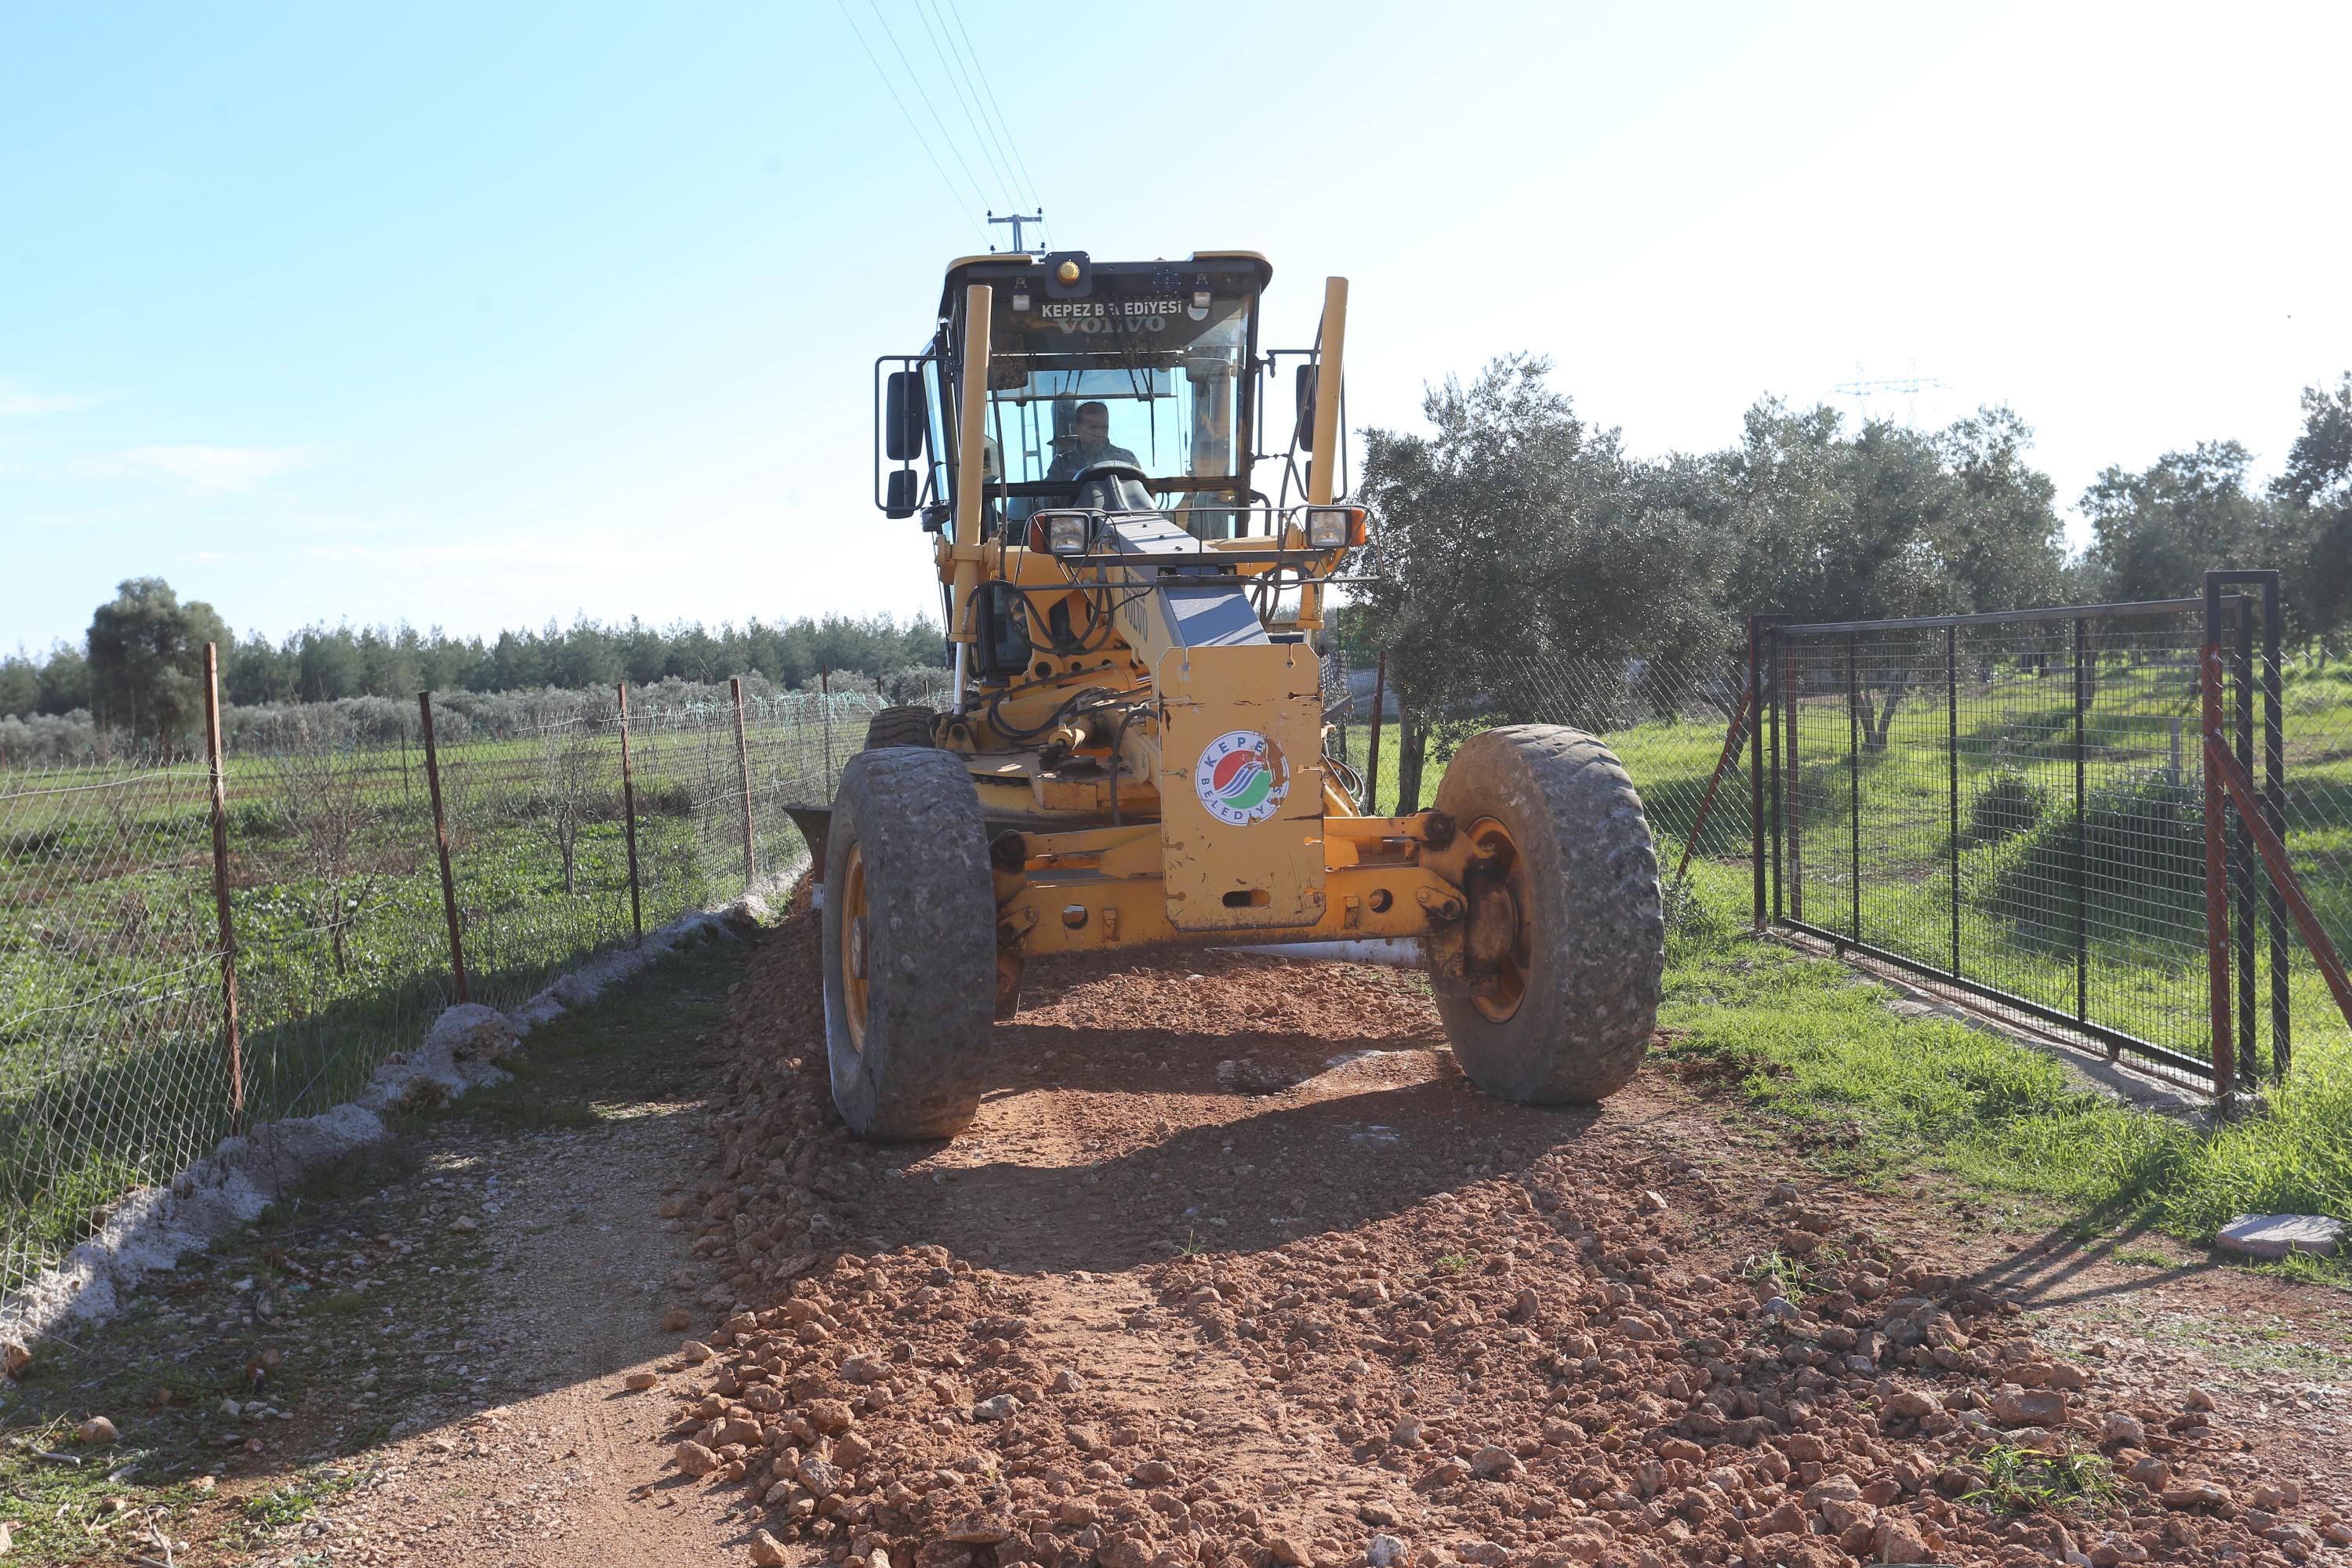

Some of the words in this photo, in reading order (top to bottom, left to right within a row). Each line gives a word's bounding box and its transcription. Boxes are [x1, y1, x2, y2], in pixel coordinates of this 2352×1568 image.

[1042, 303, 1091, 318] KEPEZ
[1053, 315, 1167, 334] VOLVO
[1203, 736, 1265, 768] KEPE
